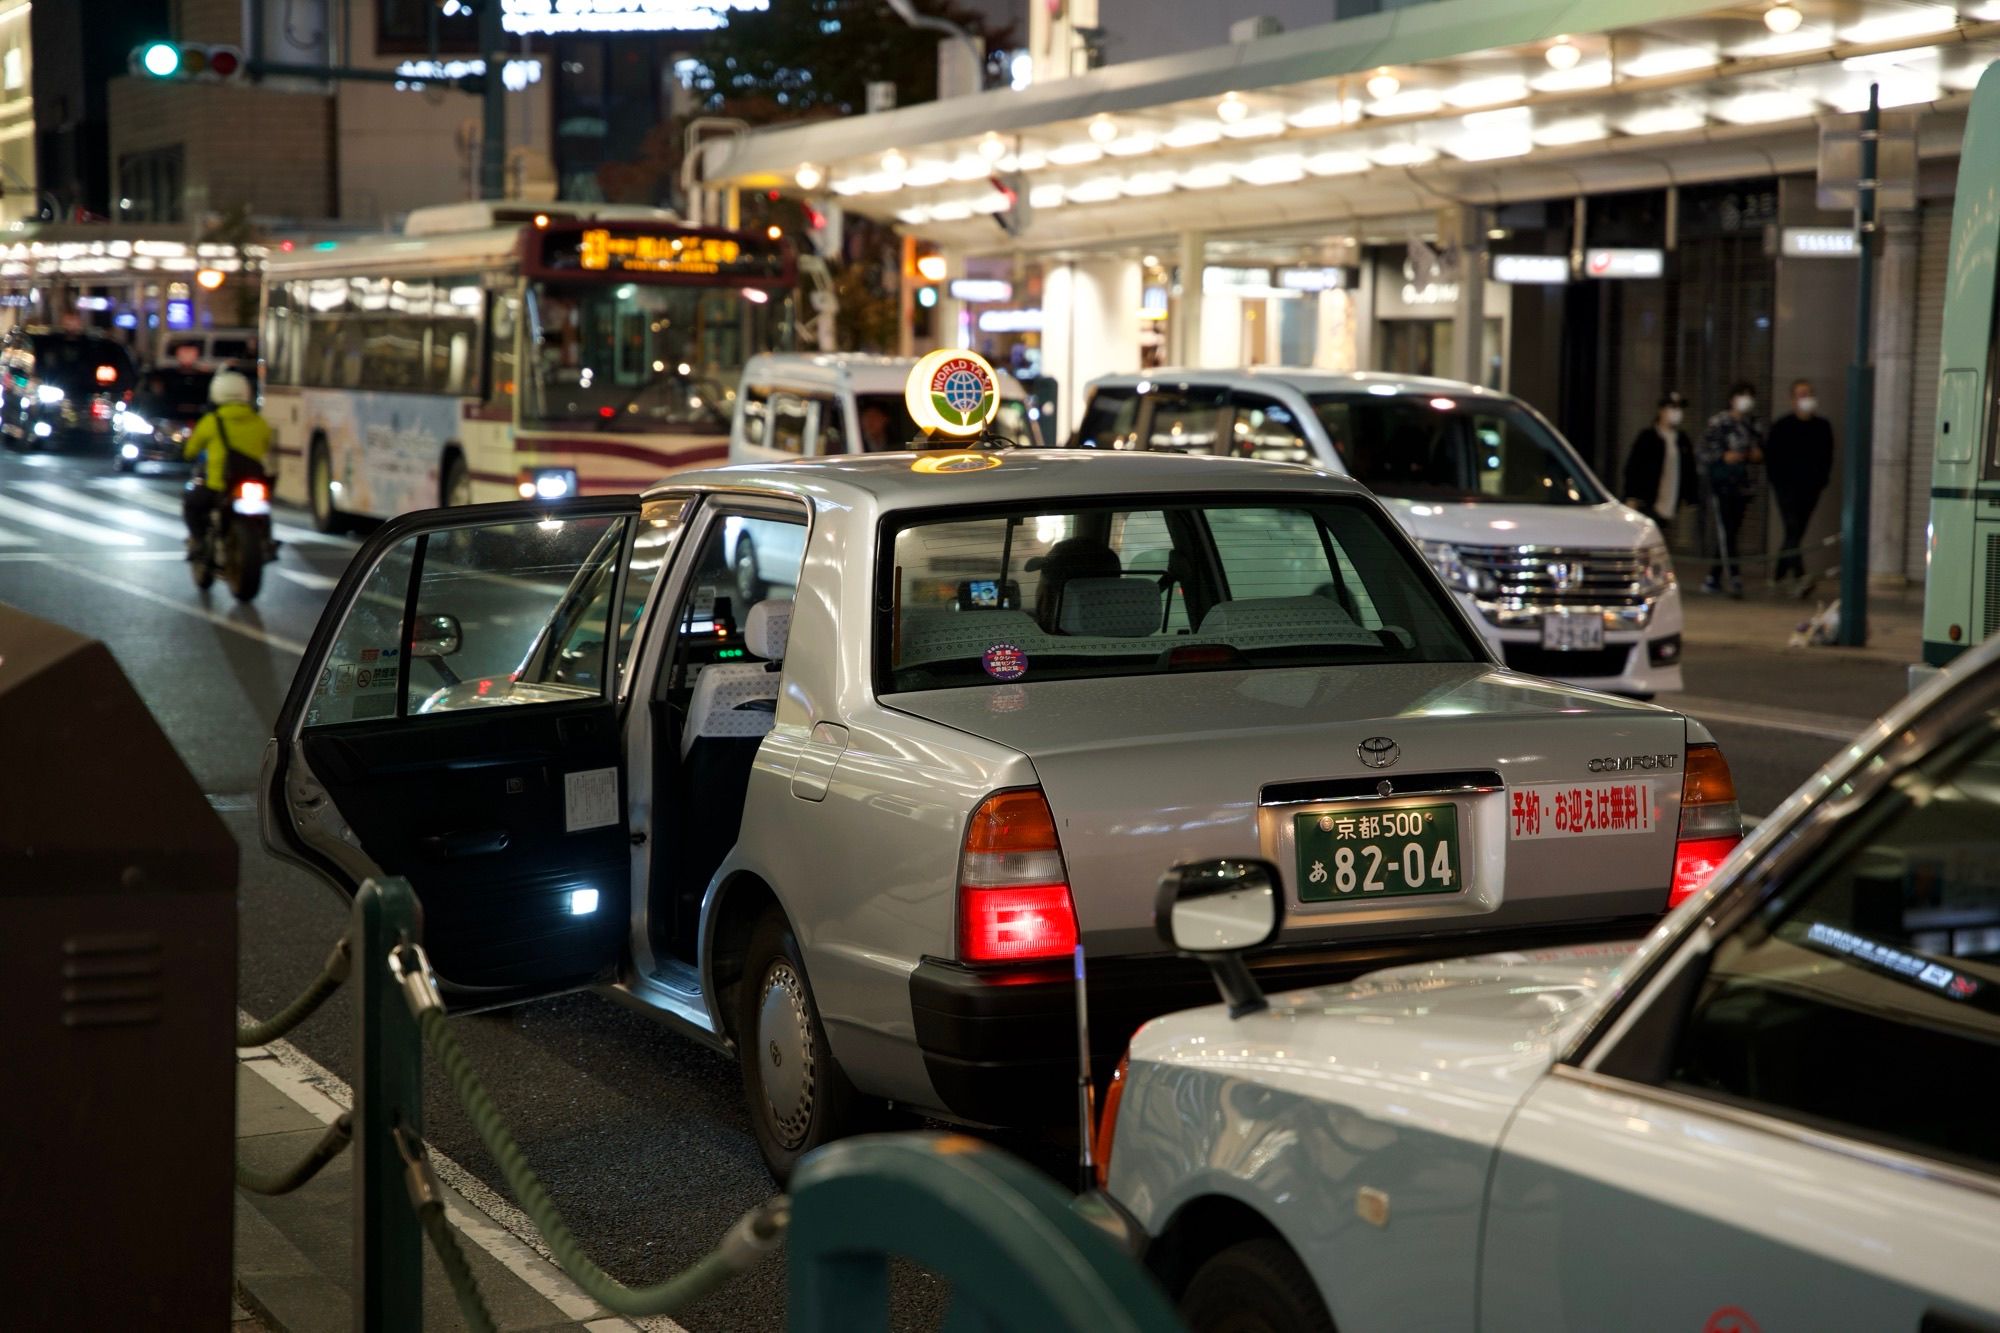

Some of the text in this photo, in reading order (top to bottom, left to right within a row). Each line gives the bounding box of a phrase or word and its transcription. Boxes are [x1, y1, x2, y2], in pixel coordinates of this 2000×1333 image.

[932, 360, 992, 391] WORLD TAXI
[1587, 754, 1678, 773] COMFORT
[1308, 840, 1453, 893] あ 82-04
